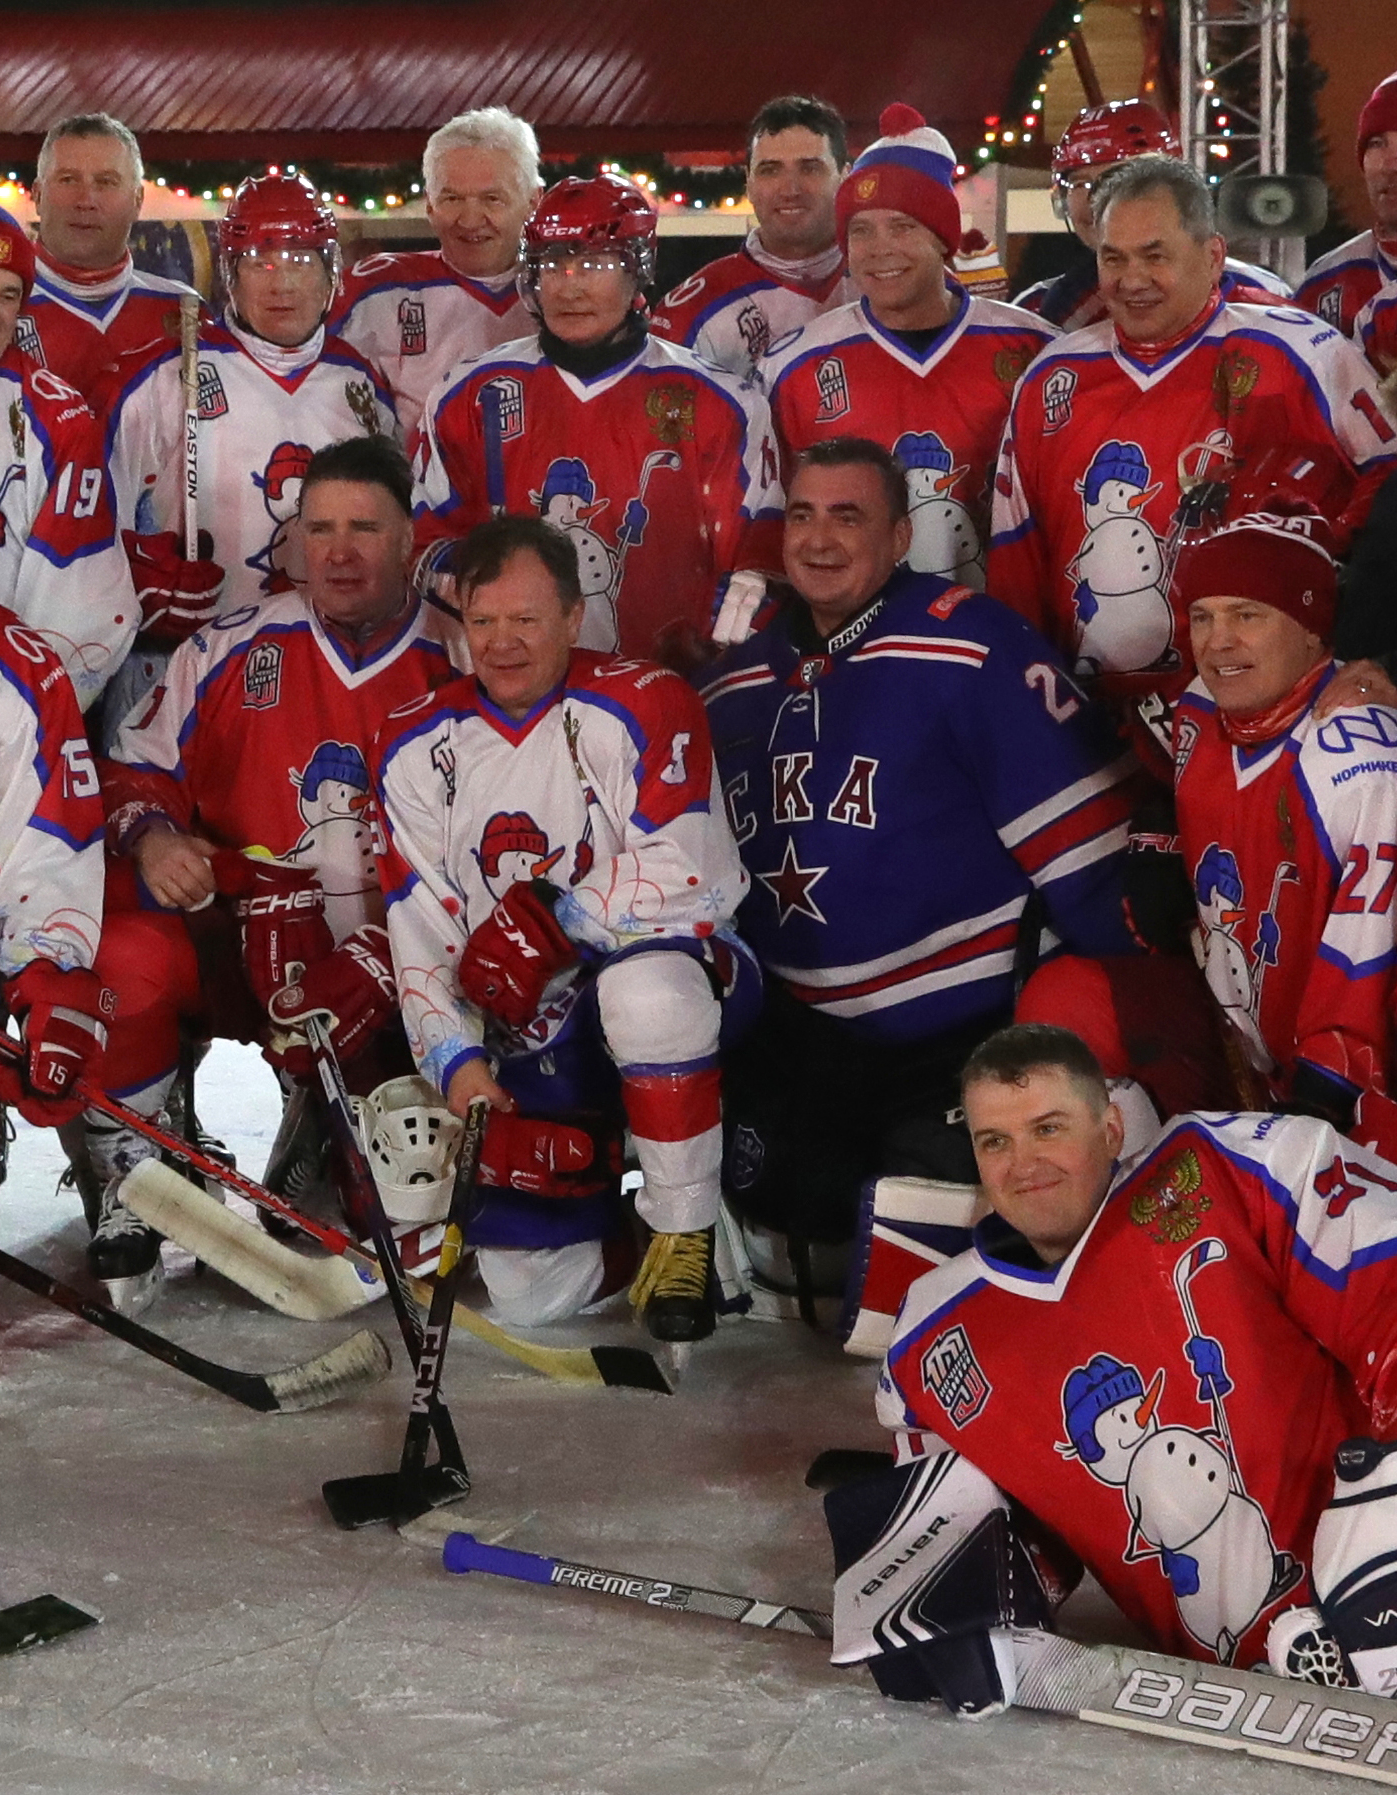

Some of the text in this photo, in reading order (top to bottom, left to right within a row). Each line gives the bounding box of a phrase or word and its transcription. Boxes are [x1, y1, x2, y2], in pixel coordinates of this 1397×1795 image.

[544, 227, 584, 237] CCM
[185, 413, 199, 501] EASTON
[55, 461, 103, 518] 19
[60, 737, 101, 799] 15
[1330, 759, 1397, 788] НОРНИКЕ
[1327, 842, 1397, 915] 27
[47, 1060, 69, 1086] 15
[551, 1566, 644, 1598] PREME
[860, 1514, 949, 1598] BAUER
